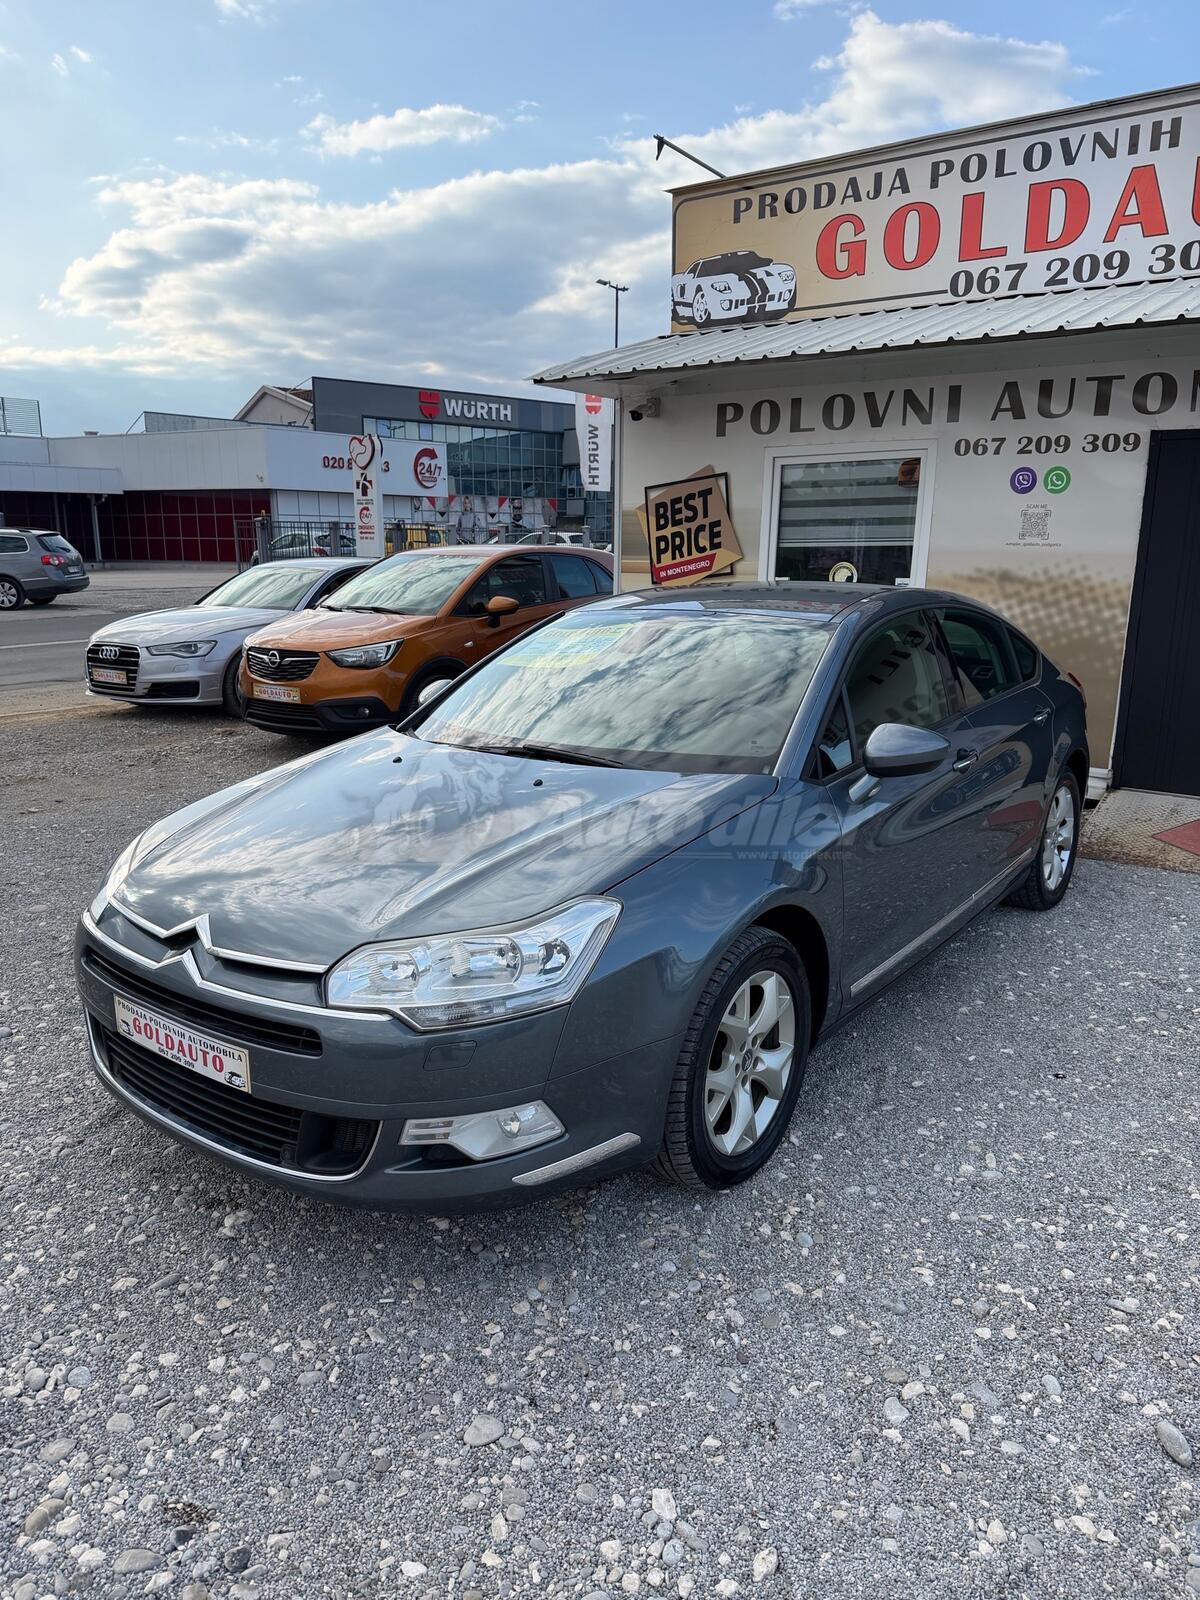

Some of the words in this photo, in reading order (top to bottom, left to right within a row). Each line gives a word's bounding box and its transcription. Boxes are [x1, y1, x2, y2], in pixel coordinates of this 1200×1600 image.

[732, 167, 911, 225] PRODAJA
[930, 116, 1183, 190] POLOVNIH
[815, 155, 1200, 281] GOLDA
[949, 262, 1028, 299] 067
[1044, 249, 1130, 287] 209
[444, 398, 512, 422] WÜRTH
[715, 384, 963, 438] POLOVNI
[990, 370, 1200, 421] AUTO
[322, 456, 345, 470] 020
[954, 437, 1007, 458] 067
[1016, 434, 1071, 455] 209
[1081, 432, 1141, 453] 309
[419, 462, 442, 477] 24/7
[655, 487, 713, 532] BEST
[655, 519, 722, 564] PRICE
[660, 570, 667, 578] IN
[667, 560, 710, 576] MONTENEGRO
[259, 688, 292, 698] GOLDAUTO
[117, 1000, 148, 1021] PRODAJA
[149, 1016, 186, 1040] POLOVNIH
[188, 1034, 243, 1062] AUTOMOBILA
[132, 1017, 225, 1073] GOLDAUTO
